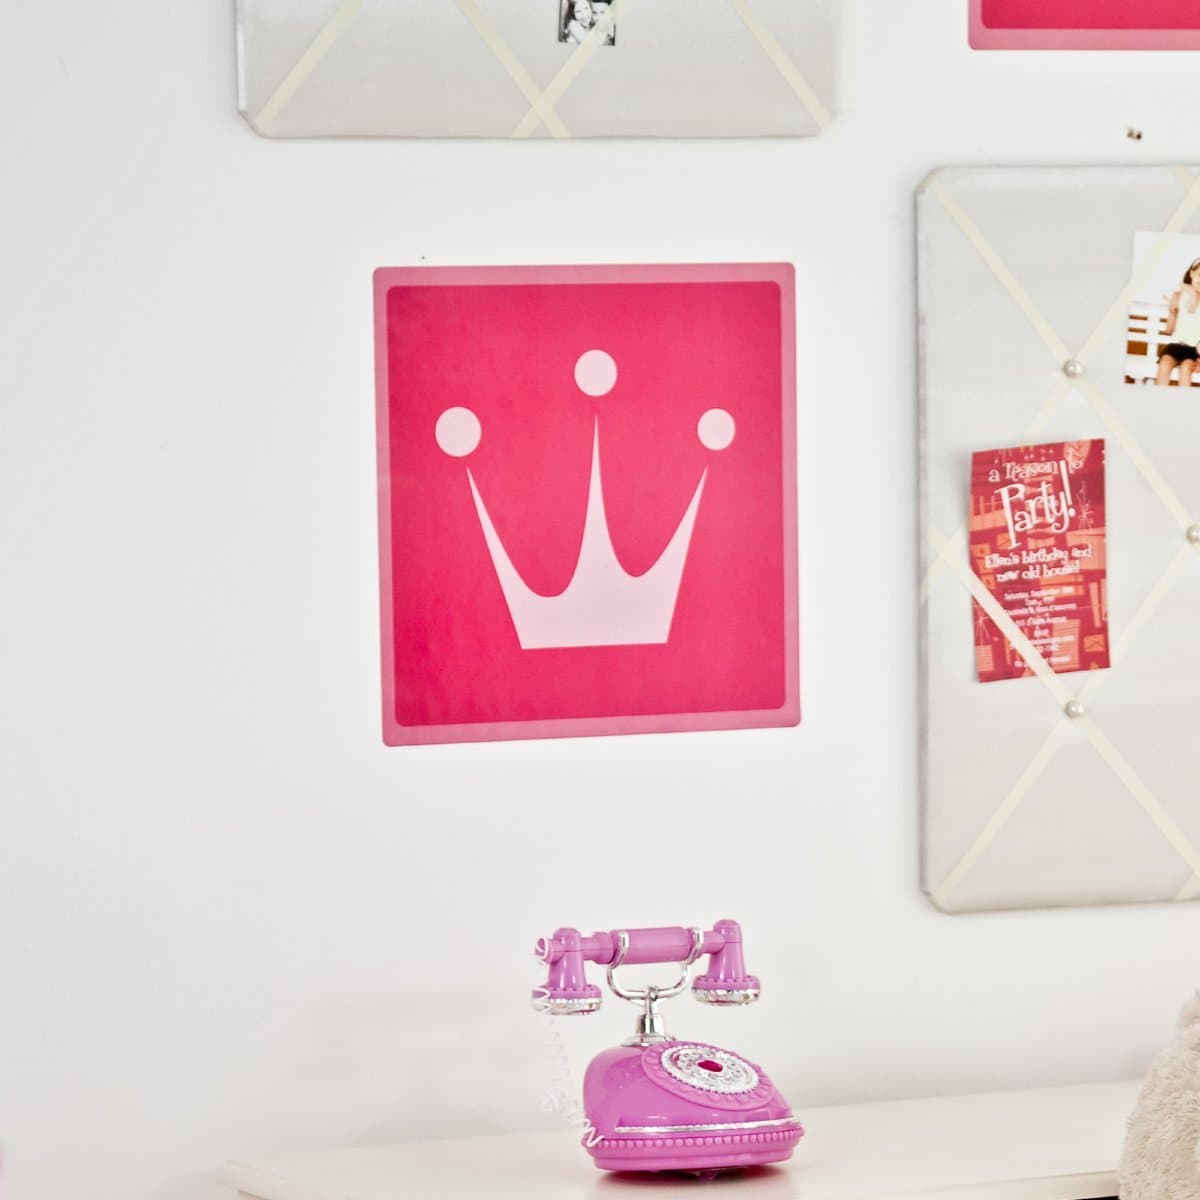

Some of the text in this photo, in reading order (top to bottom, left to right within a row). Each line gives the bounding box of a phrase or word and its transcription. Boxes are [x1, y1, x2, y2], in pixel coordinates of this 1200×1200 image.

[988, 446, 1083, 483] a reason to
[993, 459, 1077, 550] Party!
[1021, 546, 1069, 566] birthday
[1071, 542, 1092, 558] and
[1021, 564, 1041, 579] old
